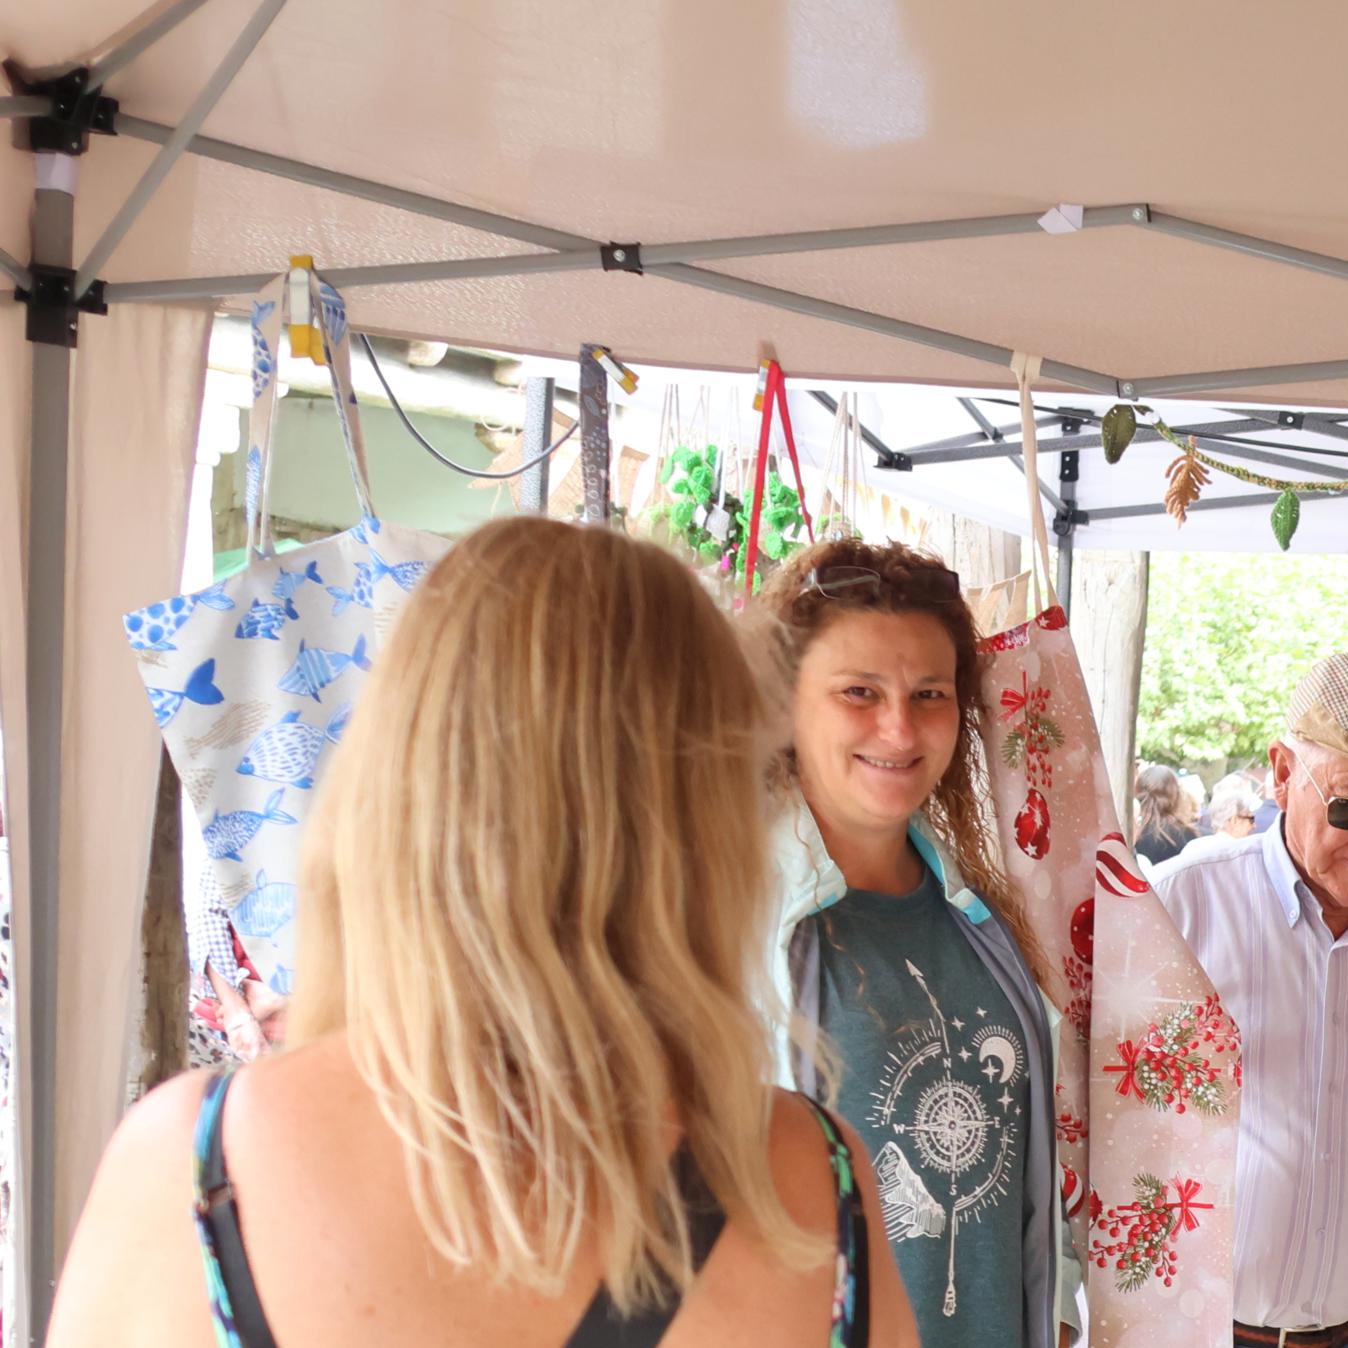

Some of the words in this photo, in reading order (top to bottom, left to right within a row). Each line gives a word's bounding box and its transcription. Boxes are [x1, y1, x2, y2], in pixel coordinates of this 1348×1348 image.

[943, 1057, 952, 1068] N
[893, 1123, 905, 1135] W
[949, 1184, 958, 1196] S
